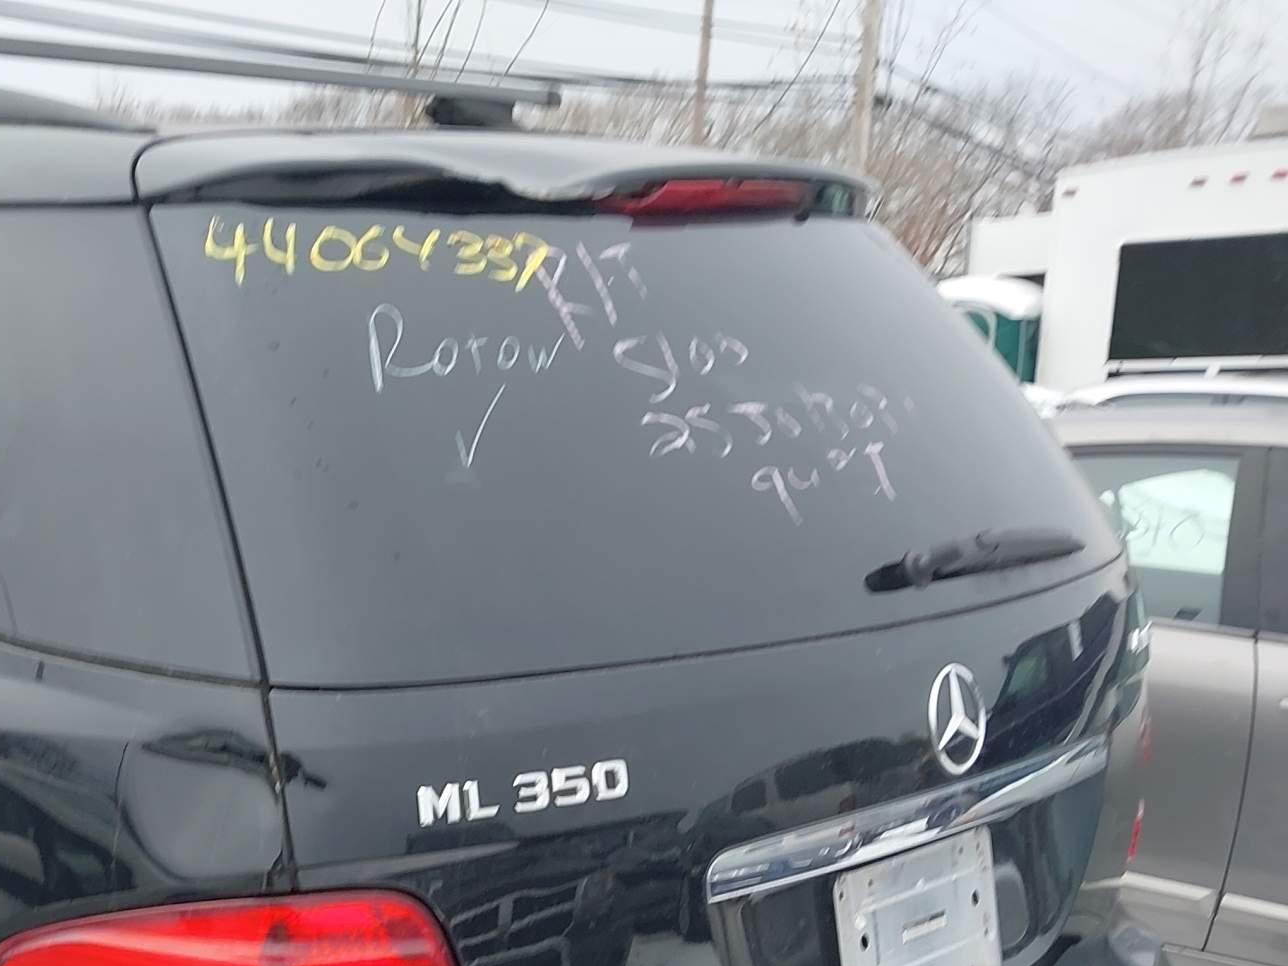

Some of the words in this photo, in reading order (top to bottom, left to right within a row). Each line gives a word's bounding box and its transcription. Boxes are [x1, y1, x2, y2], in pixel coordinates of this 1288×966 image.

[205, 215, 550, 293] 44064337
[415, 779, 500, 828] ML
[511, 758, 629, 815] 350
